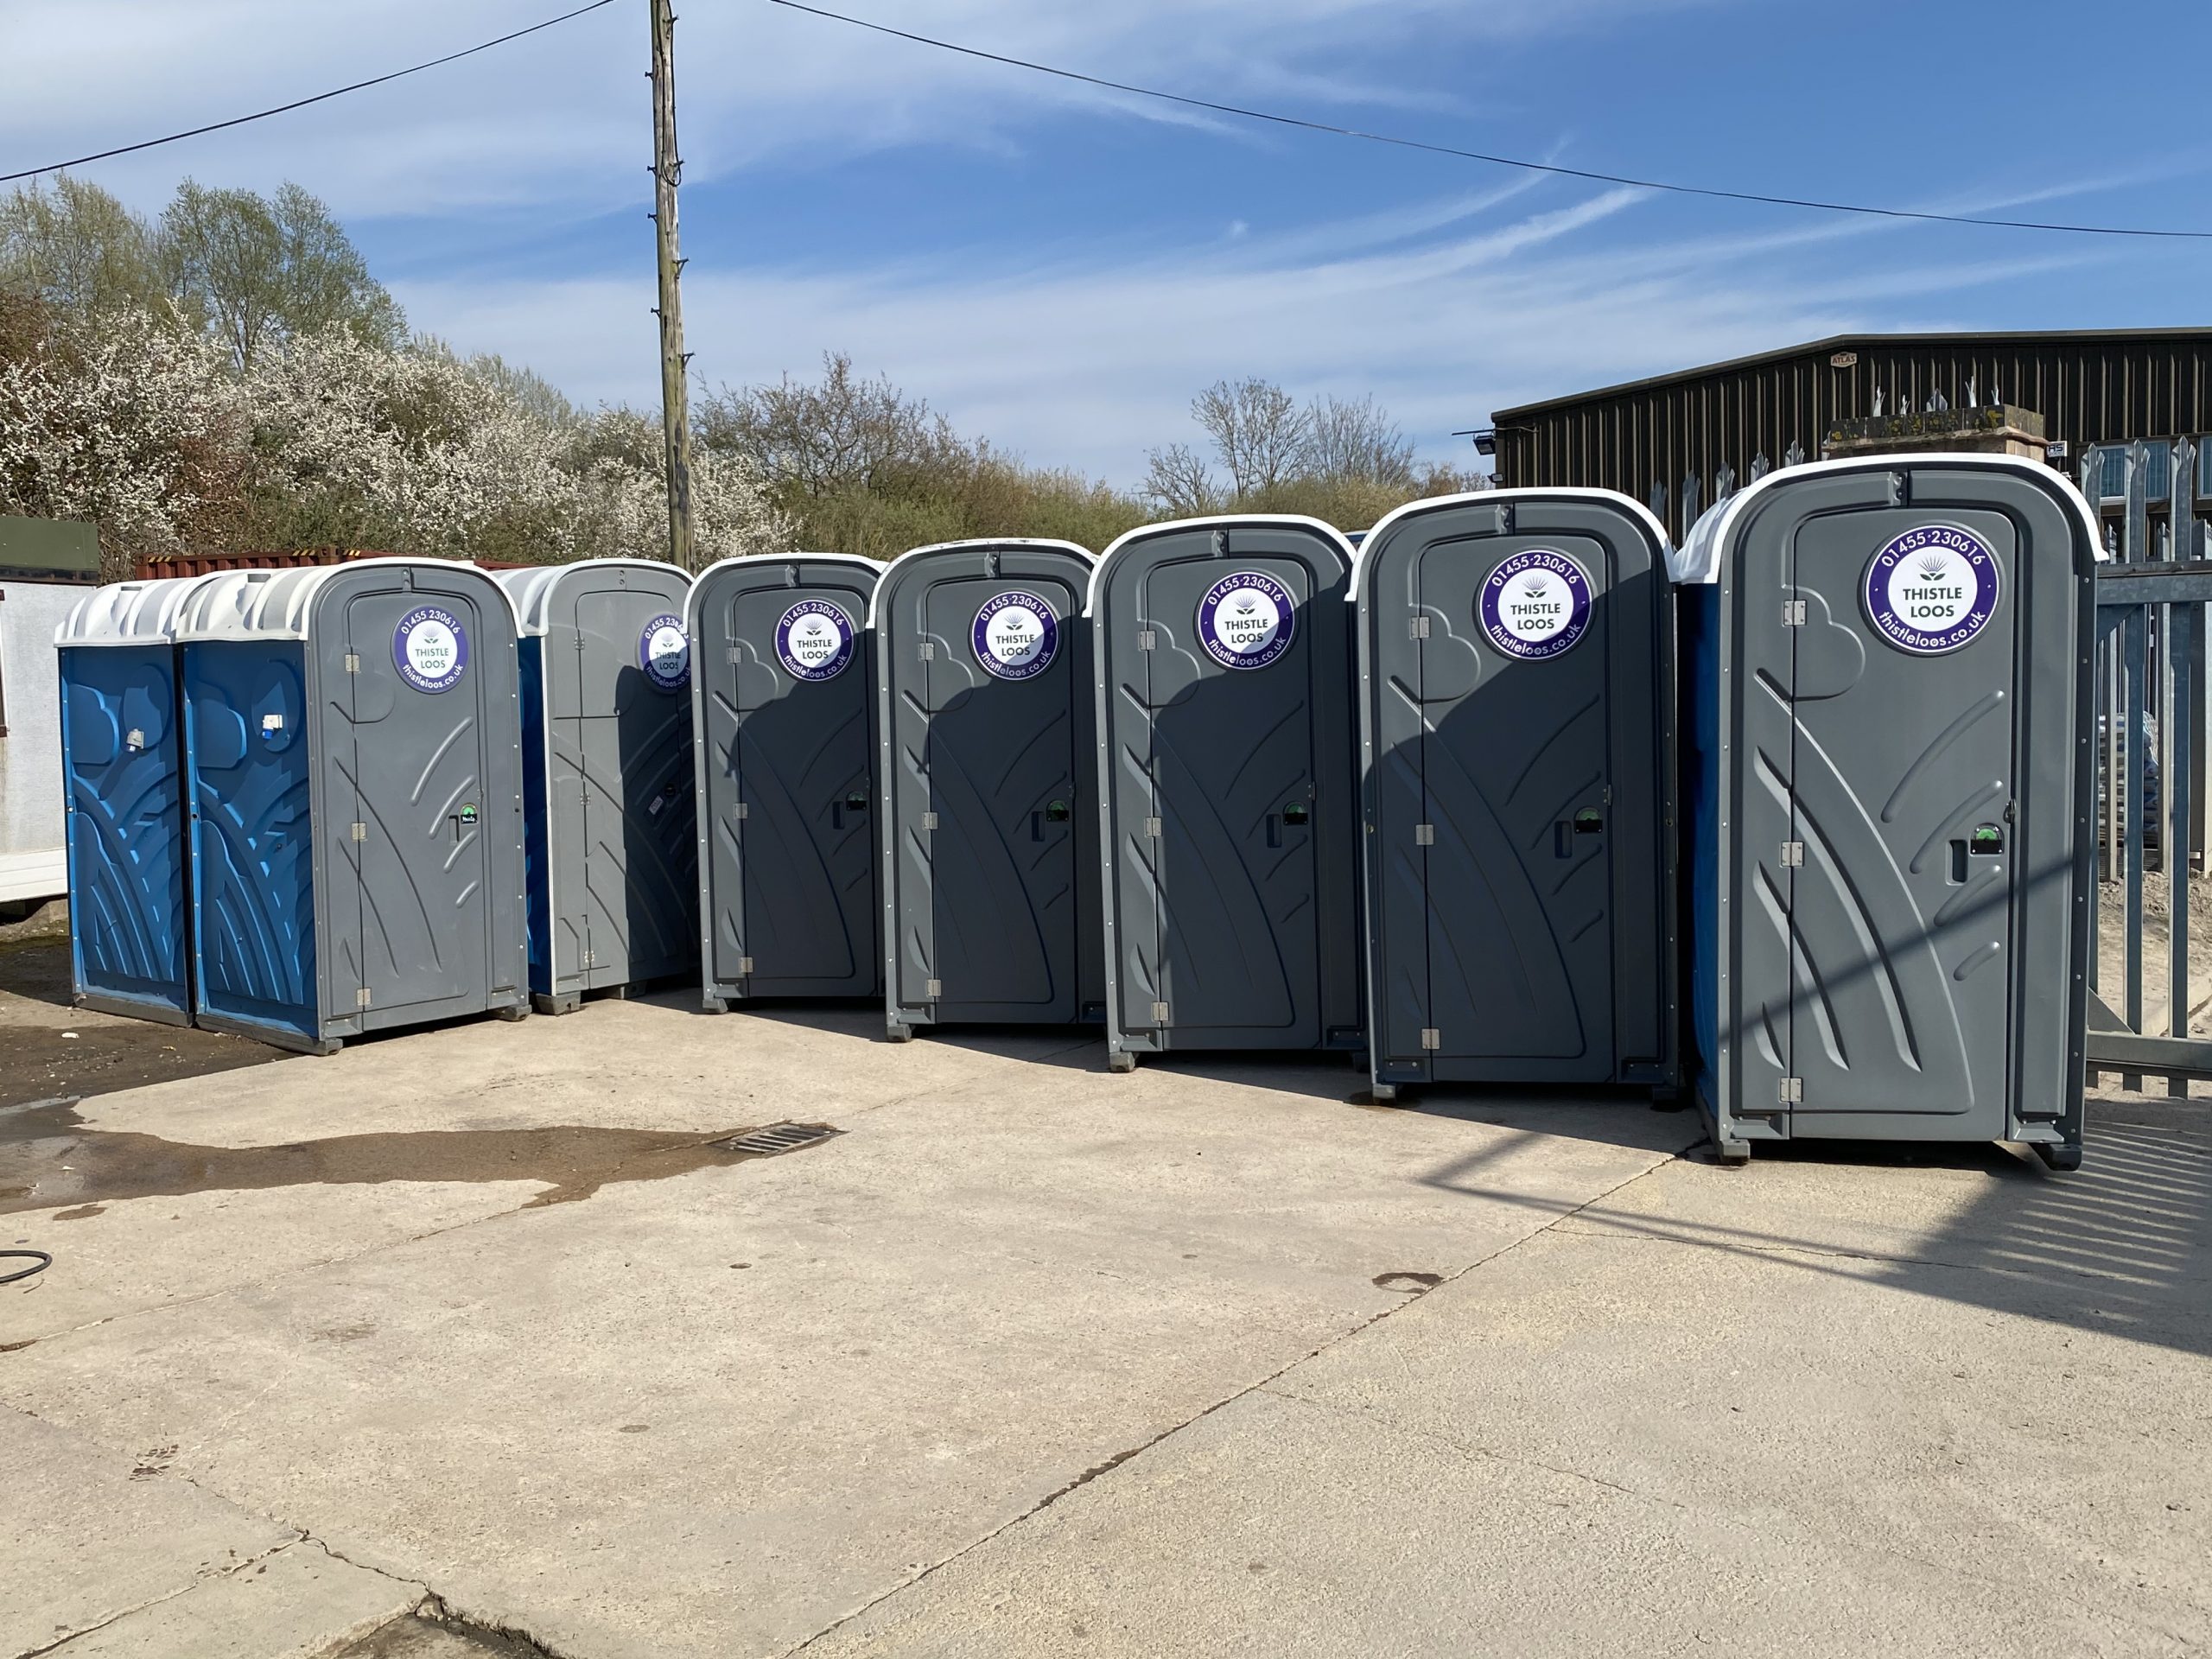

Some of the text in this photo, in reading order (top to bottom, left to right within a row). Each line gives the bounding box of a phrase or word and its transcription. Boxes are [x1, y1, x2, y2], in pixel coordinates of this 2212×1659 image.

[1832, 355, 1855, 364] ATLAS
[1881, 531, 1986, 568] 01455 230616
[1491, 554, 1580, 587] 01455 230616
[1208, 575, 1284, 606] 01455 230616
[1903, 587, 1962, 601] THISTLE
[981, 594, 1049, 621] 01455 230616
[1510, 603, 1561, 615] THISTLE
[1910, 605, 1955, 618] LOOS
[401, 609, 461, 634] 01455 230616
[783, 603, 845, 627] 01455 230616
[1224, 619, 1268, 630] THISTLE
[1517, 619, 1555, 630] LOOS
[1878, 611, 1986, 647] thistleloos.co.uk
[797, 639, 832, 648] THISTLE
[995, 634, 1035, 644] THISTLE
[1231, 632, 1264, 644] LOOS
[1491, 624, 1581, 655] thistleloos.co.uk
[415, 648, 448, 657] THISTLE
[802, 651, 830, 659] LOOS
[1001, 646, 1031, 657] LOOS
[1208, 637, 1287, 665] thistleloos.co.uk
[421, 660, 446, 669] LOOS
[784, 655, 848, 678] thistleloos.co.uk
[981, 651, 1051, 677] thistleloos.co.uk
[403, 664, 463, 689] thistleloos.co.uk
